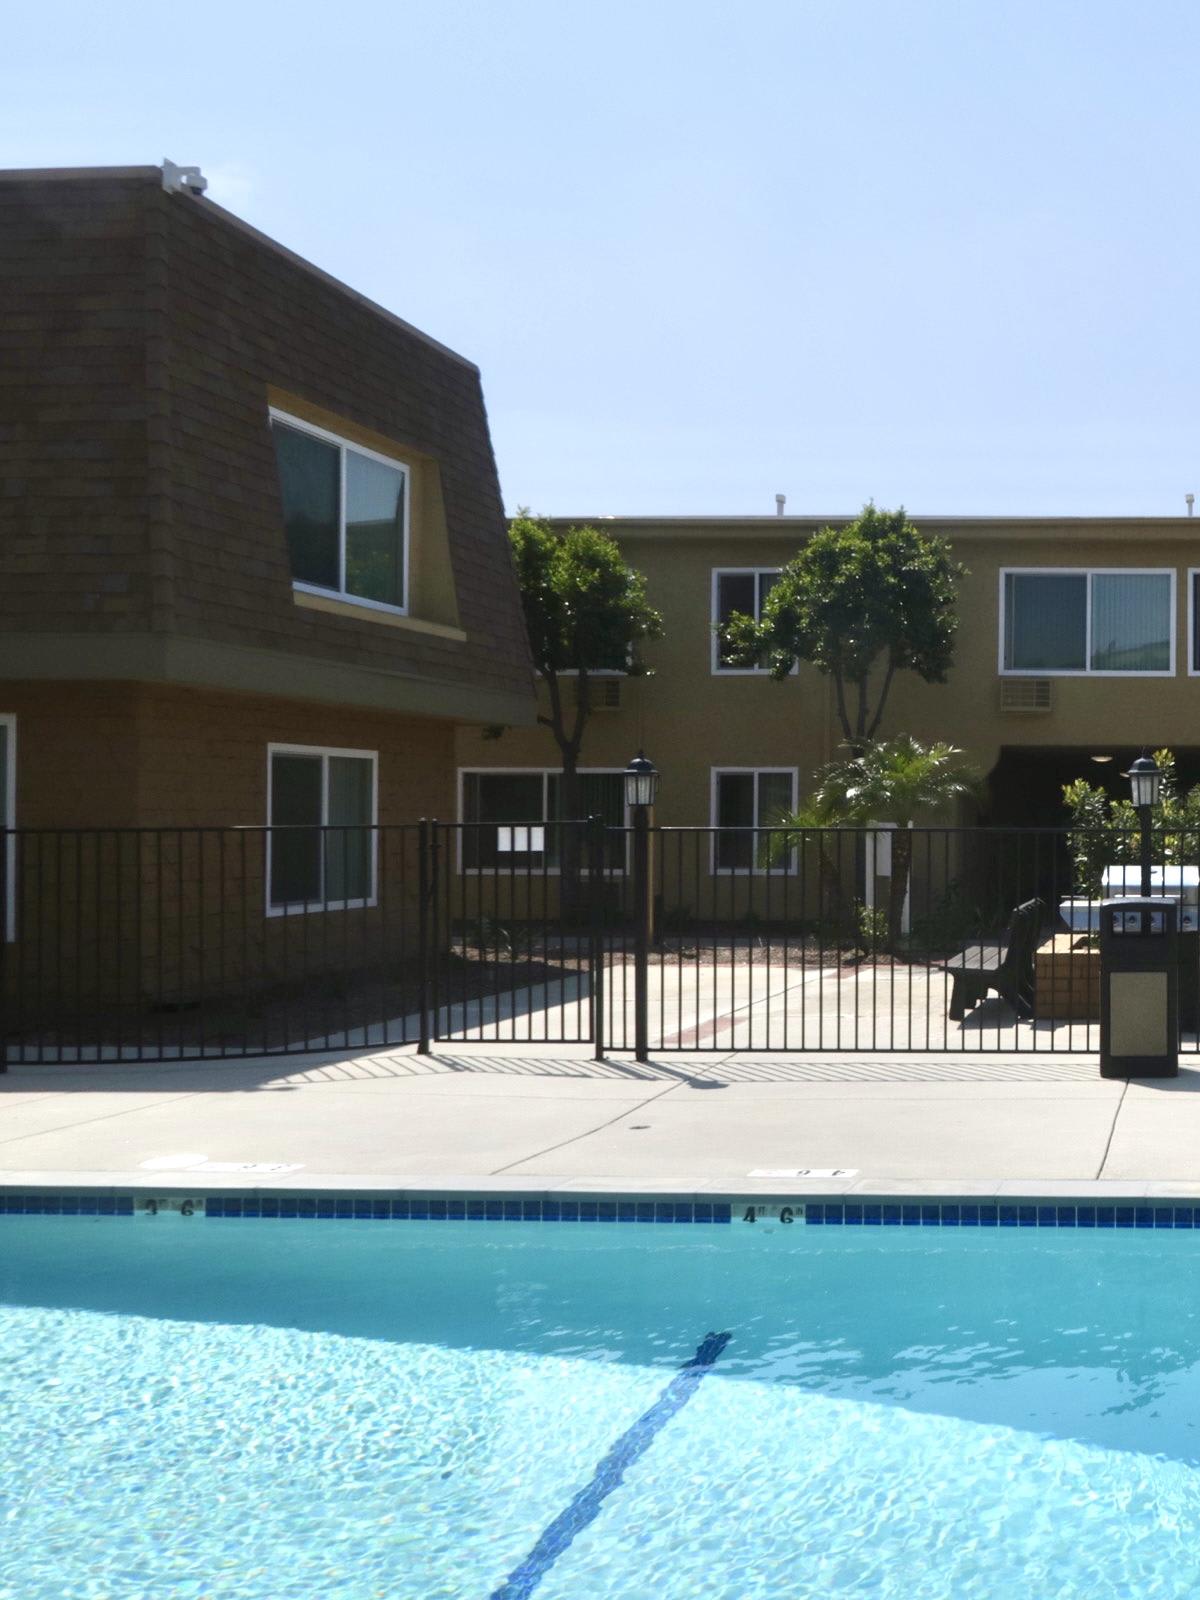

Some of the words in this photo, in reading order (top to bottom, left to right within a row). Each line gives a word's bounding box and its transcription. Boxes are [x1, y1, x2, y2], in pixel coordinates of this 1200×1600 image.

[145, 1199, 158, 1216] 3
[181, 1199, 194, 1216] 6
[742, 1206, 757, 1223] 4
[780, 1206, 794, 1224] 6
